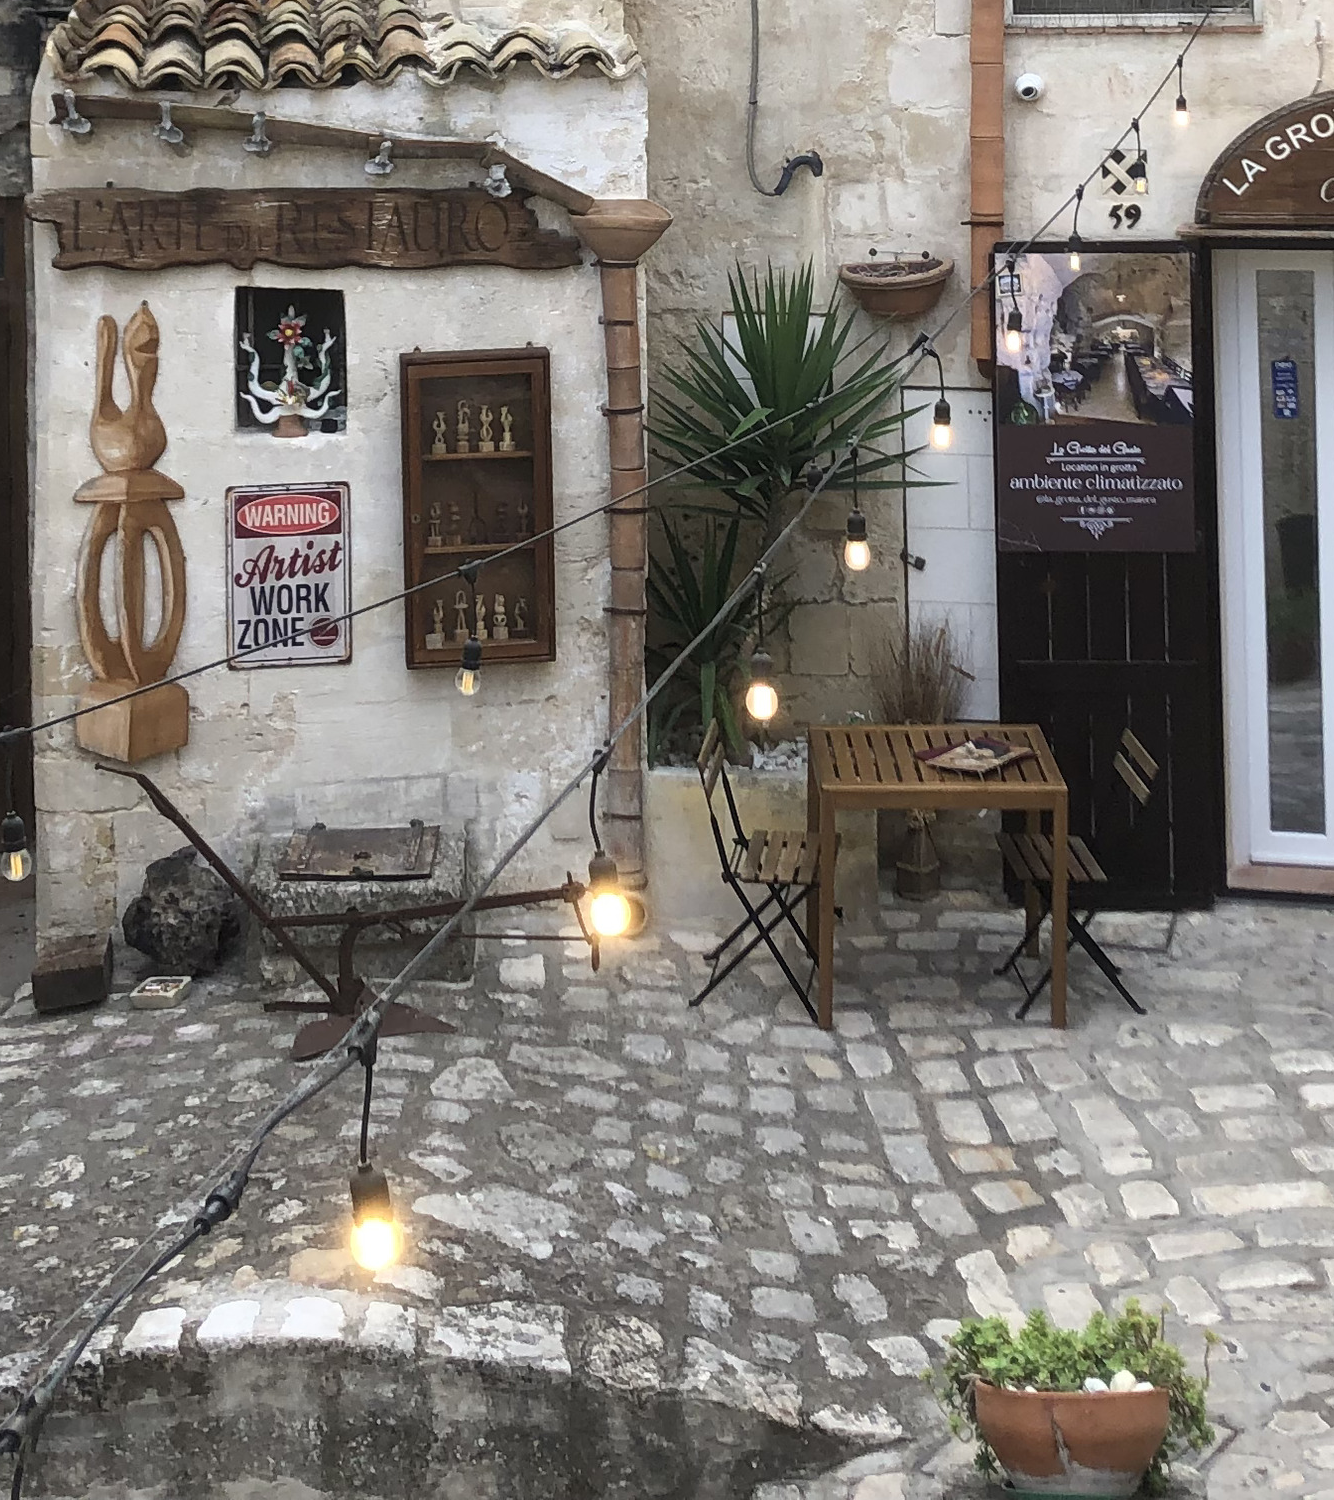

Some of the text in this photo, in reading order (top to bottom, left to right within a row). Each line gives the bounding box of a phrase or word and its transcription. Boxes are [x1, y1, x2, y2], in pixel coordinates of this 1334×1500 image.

[1222, 158, 1267, 196] LA
[70, 199, 216, 257] L'ARTE
[275, 198, 510, 257] RESTAURO
[1109, 203, 1142, 230] 59
[1009, 473, 1184, 491] ambiente climatizzato
[1061, 463, 1138, 474] Location in grotta
[245, 502, 330, 527] WARNING
[234, 540, 343, 588] Artist
[250, 582, 331, 616] WORK
[237, 616, 305, 650] ZONE
